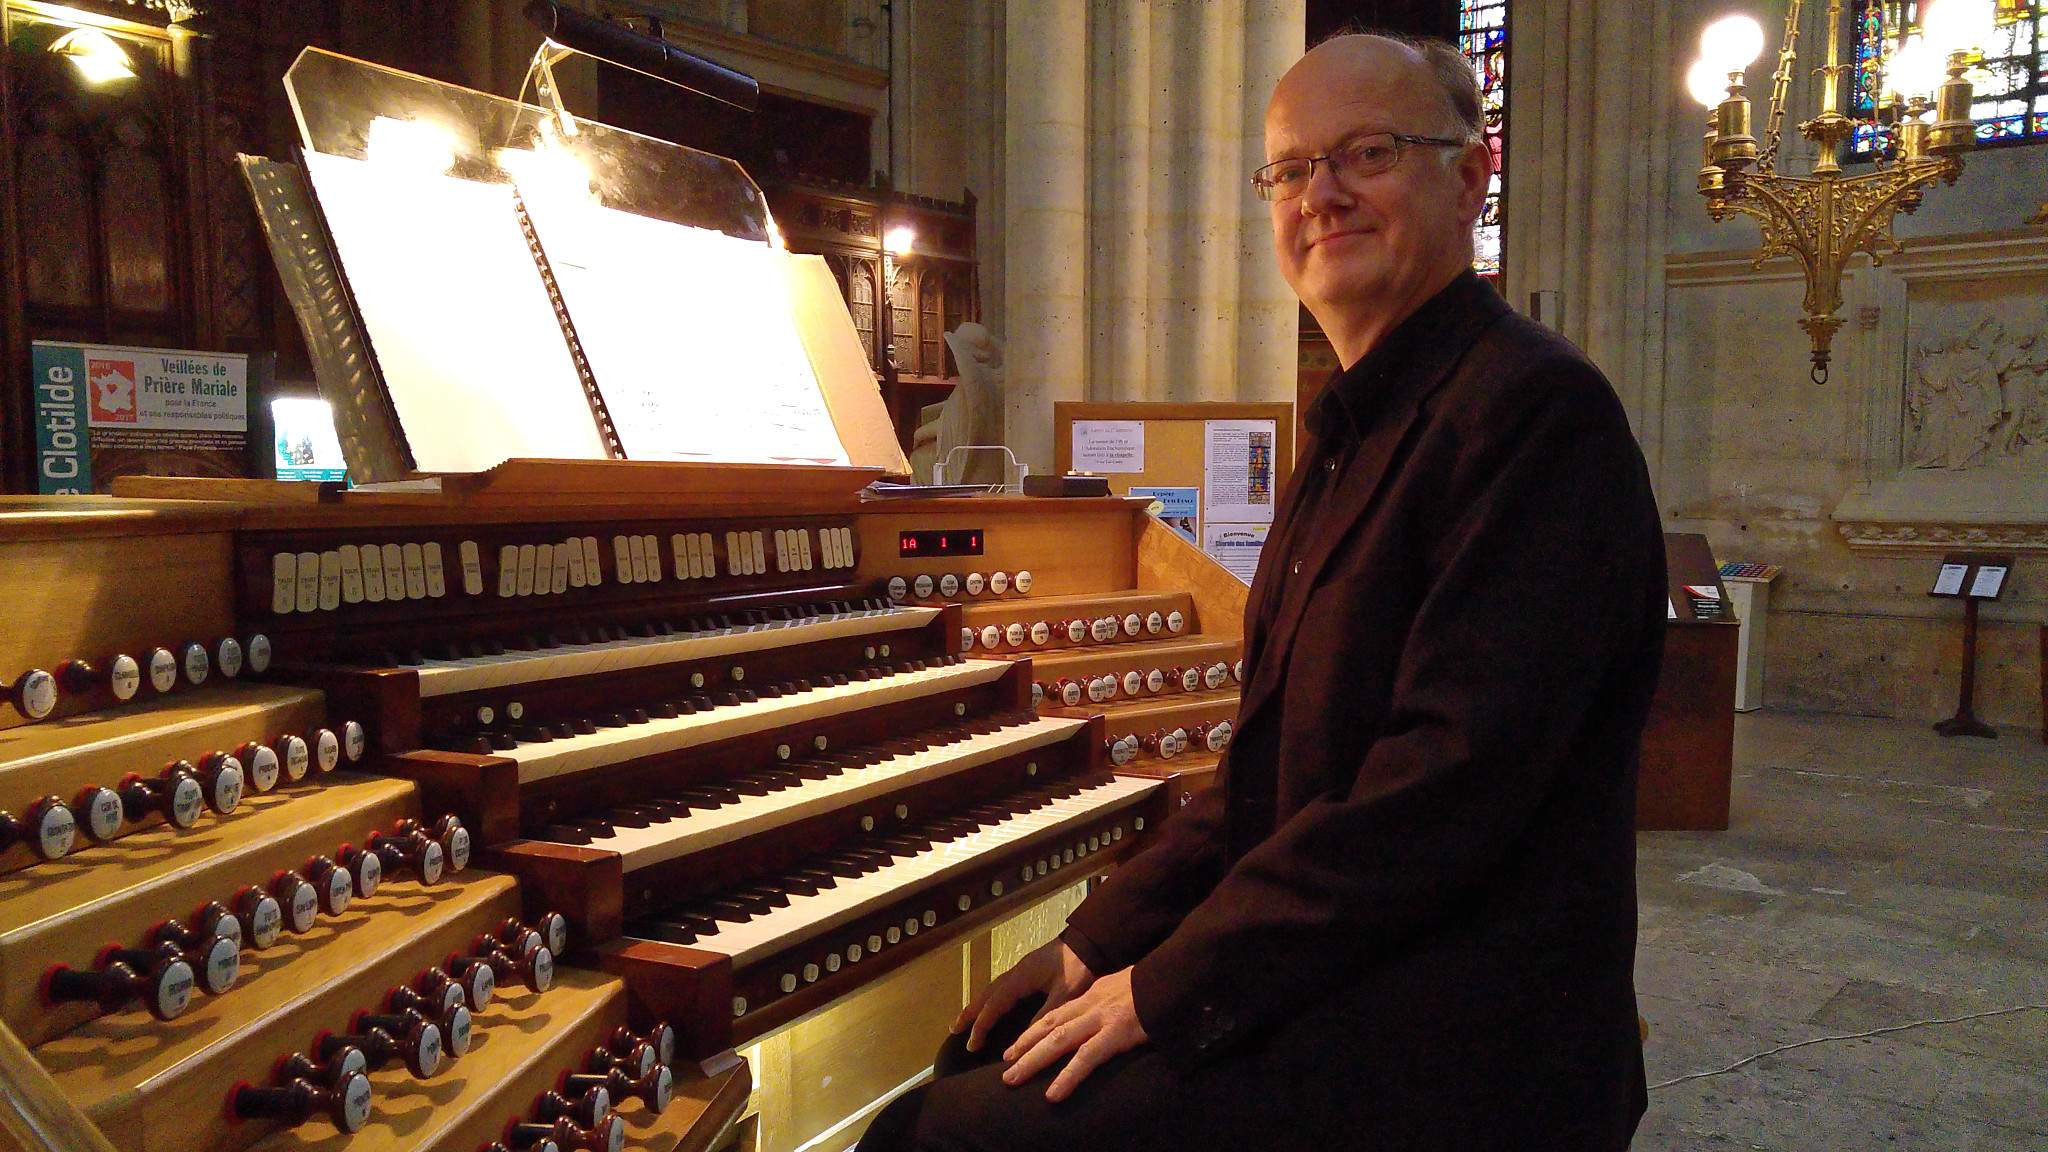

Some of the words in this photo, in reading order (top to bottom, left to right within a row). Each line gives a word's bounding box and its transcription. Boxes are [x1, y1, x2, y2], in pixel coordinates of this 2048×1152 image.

[161, 358, 208, 375] Veillées
[213, 361, 226, 376] de
[144, 376, 185, 394] Prière
[192, 378, 238, 397] Mariale
[192, 400, 217, 408] France
[40, 366, 78, 478] Clotilde
[902, 537, 917, 549] 1A
[941, 537, 947, 548] 1
[971, 536, 977, 547] 1
